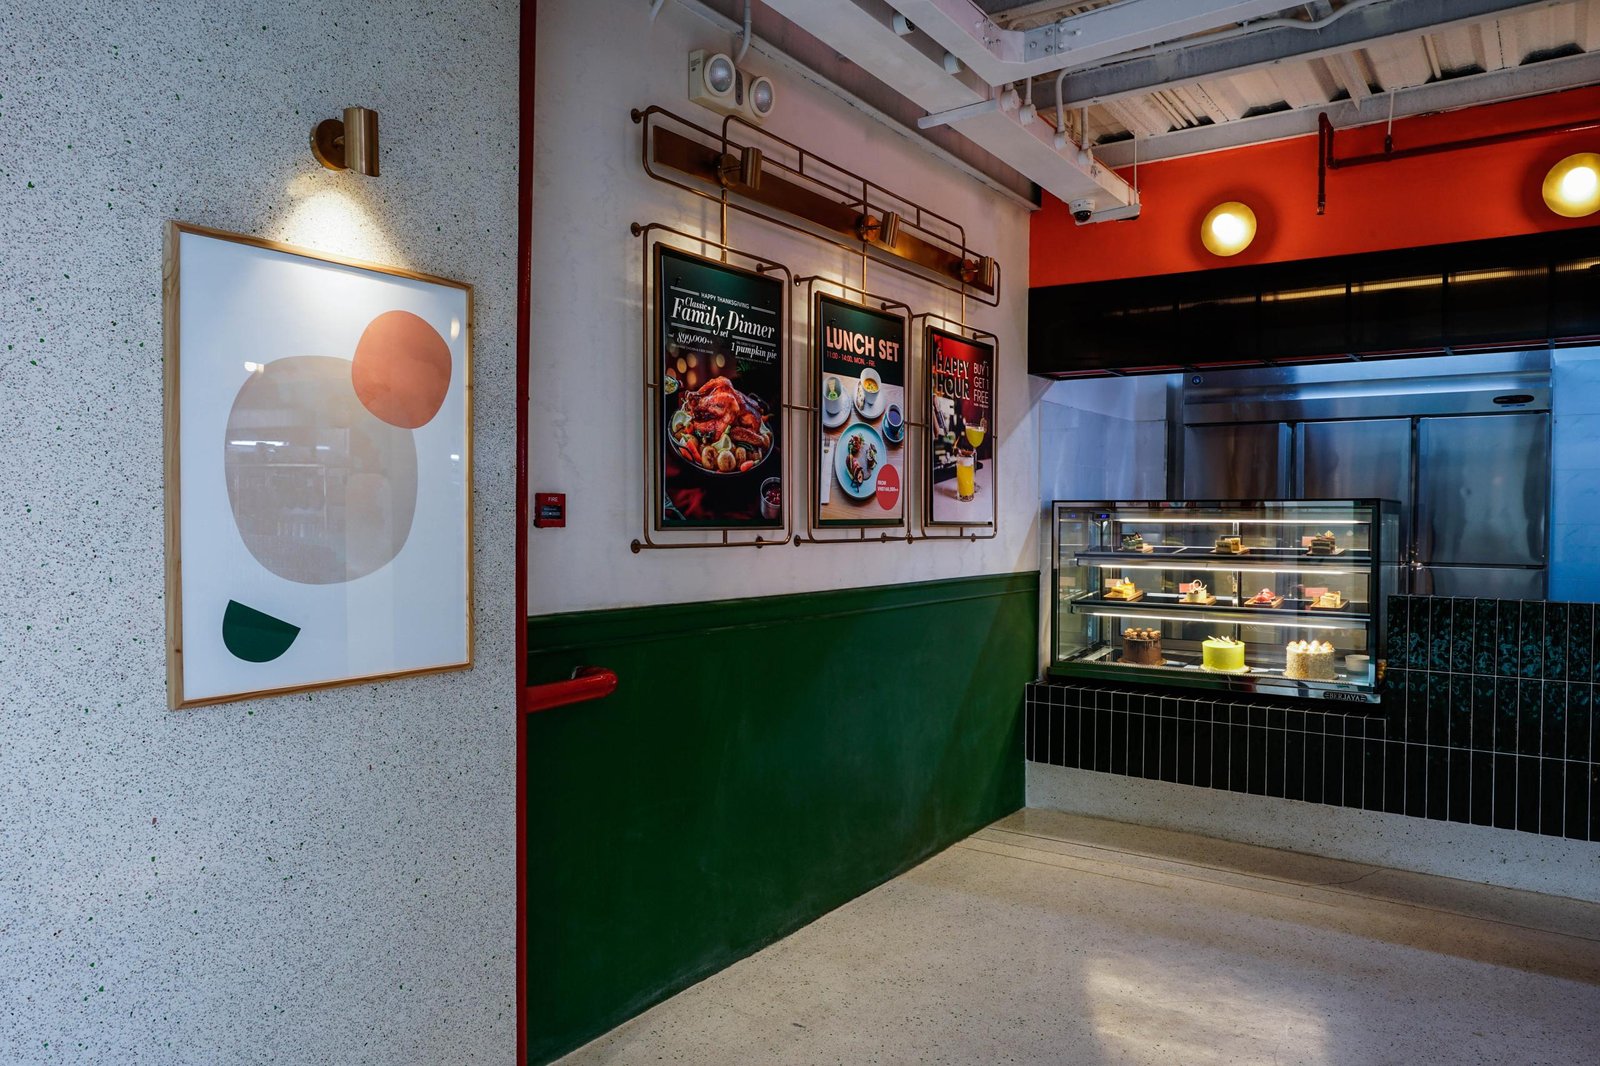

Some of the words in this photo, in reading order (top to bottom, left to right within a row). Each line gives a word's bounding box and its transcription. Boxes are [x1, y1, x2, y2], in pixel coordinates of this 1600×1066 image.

[685, 297, 708, 310] Classic
[701, 292, 716, 301] HAPPY
[717, 296, 750, 309] THANKSGIVING
[670, 297, 724, 335] Family
[726, 310, 775, 339] Dinner
[720, 330, 729, 338] set
[826, 325, 875, 357] LUNCH
[878, 339, 899, 362] SET
[735, 345, 766, 358] pumpkin
[766, 349, 777, 361] pie
[936, 347, 969, 379] HAPPY
[973, 362, 985, 375] BUY
[936, 373, 970, 400] HOUR
[973, 376, 985, 389] GET
[973, 388, 989, 404] FREE
[1329, 691, 1360, 702] BERJAYA
